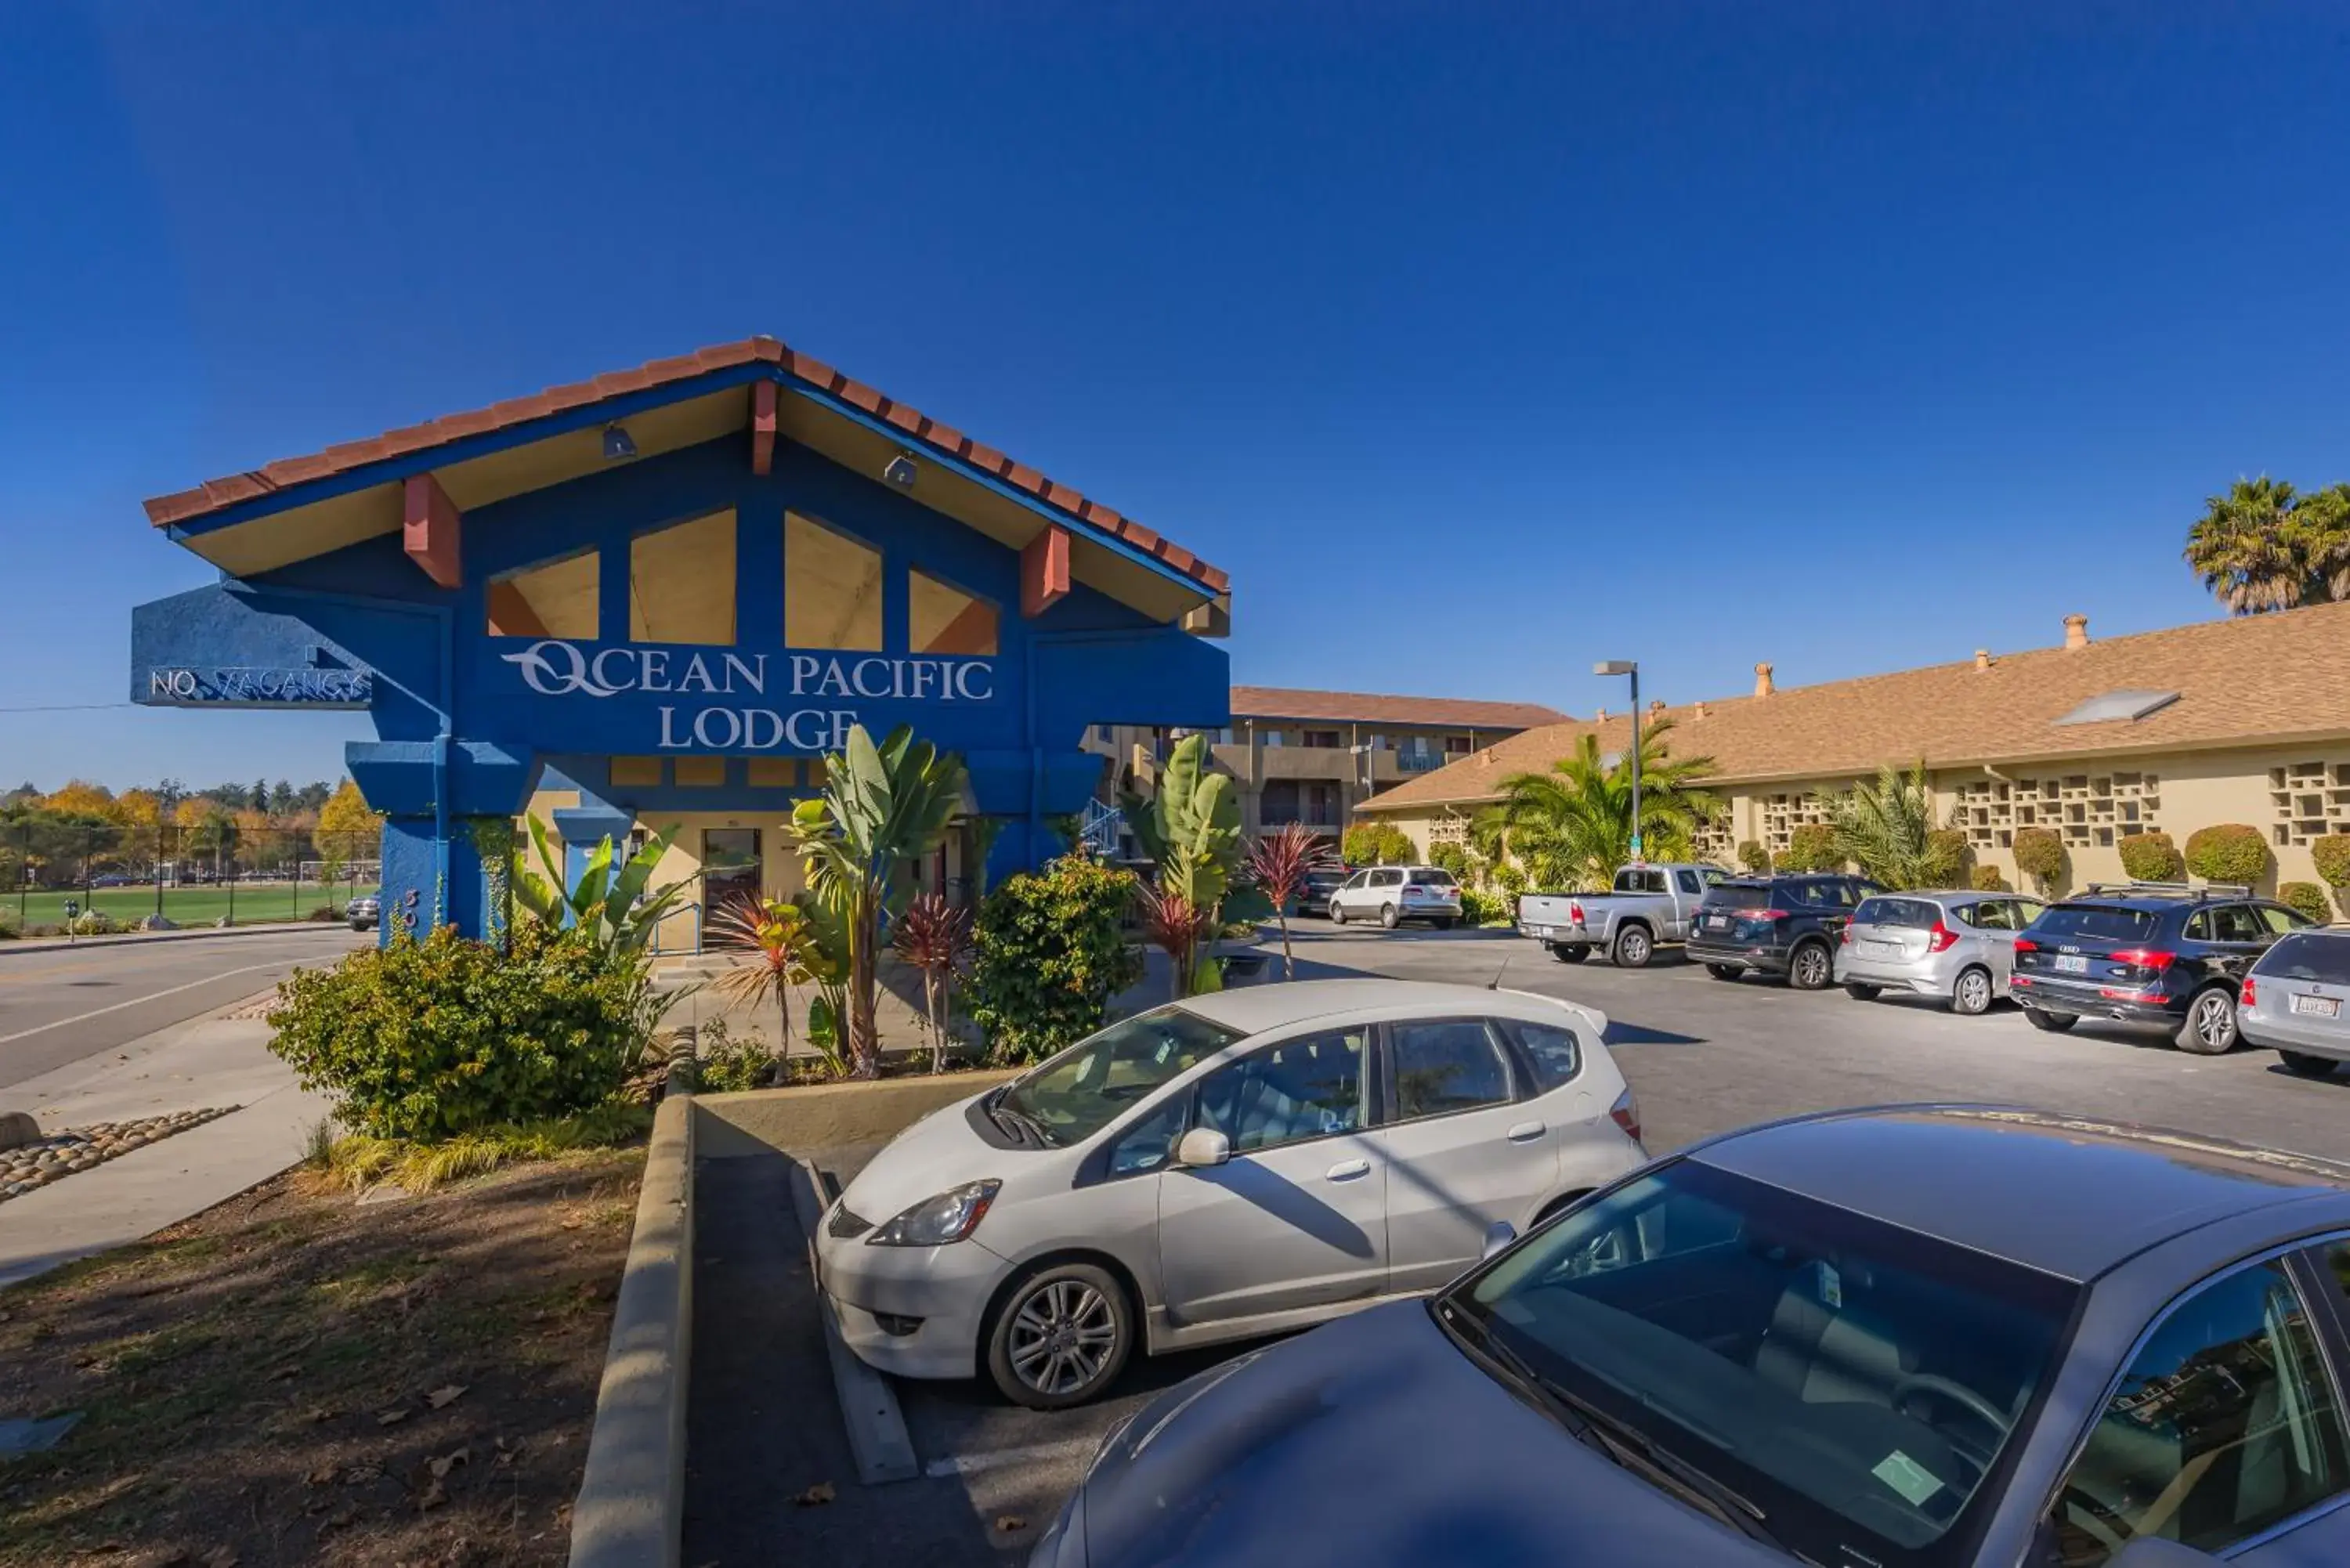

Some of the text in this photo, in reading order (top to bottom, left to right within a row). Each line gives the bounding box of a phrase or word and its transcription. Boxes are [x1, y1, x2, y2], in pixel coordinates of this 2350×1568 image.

[152, 670, 363, 695] NO VACANCY
[790, 655, 992, 700] PACIFIC
